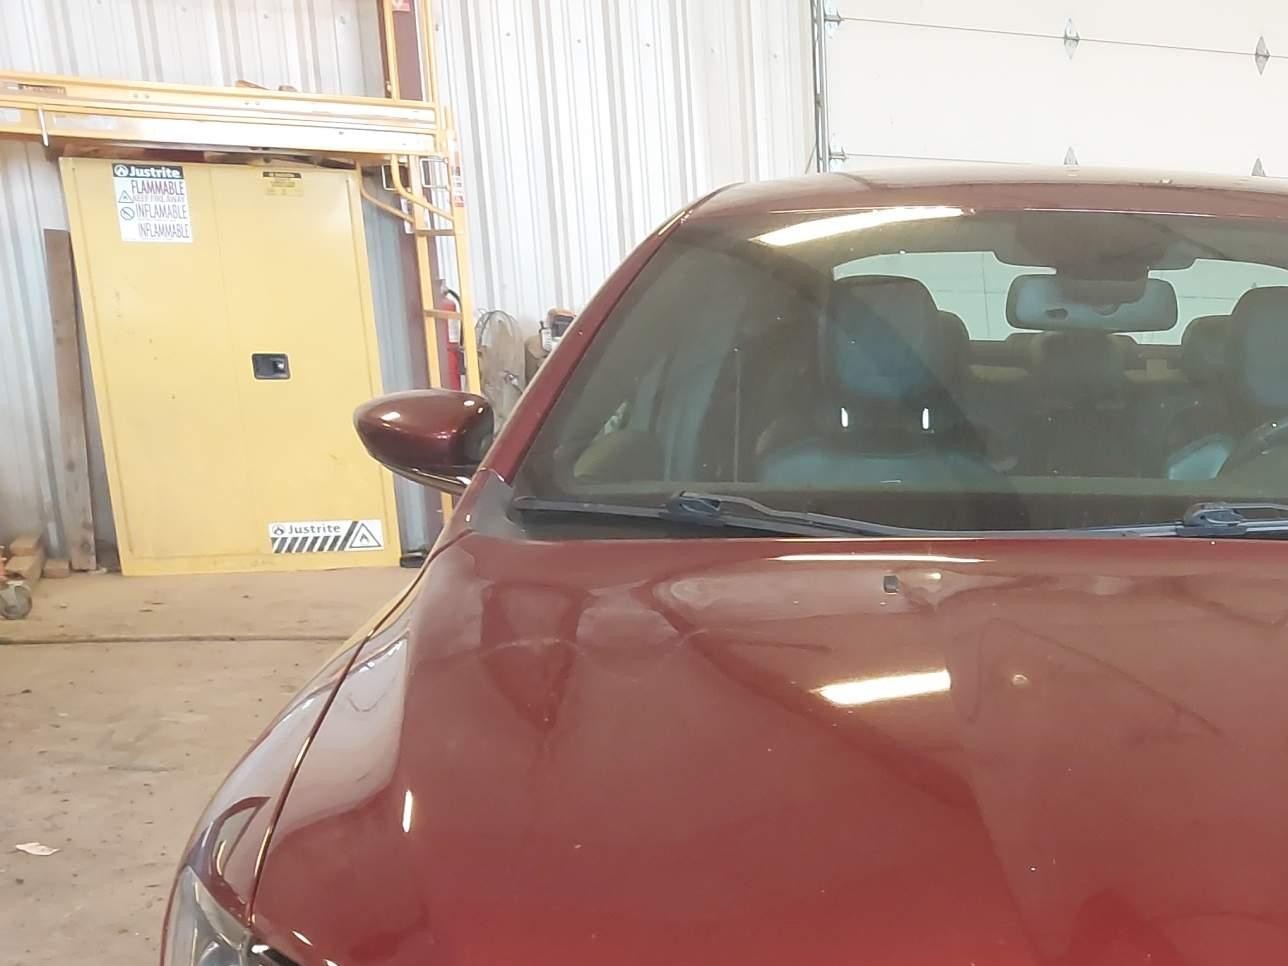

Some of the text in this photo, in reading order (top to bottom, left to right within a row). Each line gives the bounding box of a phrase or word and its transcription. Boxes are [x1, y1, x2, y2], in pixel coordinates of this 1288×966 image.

[130, 166, 181, 178] Justrite
[131, 180, 185, 196] FLAMMABLE
[135, 203, 187, 219] INFLAMABLE
[138, 223, 190, 239] INFLAMMABLE
[288, 524, 341, 535] Justrite
